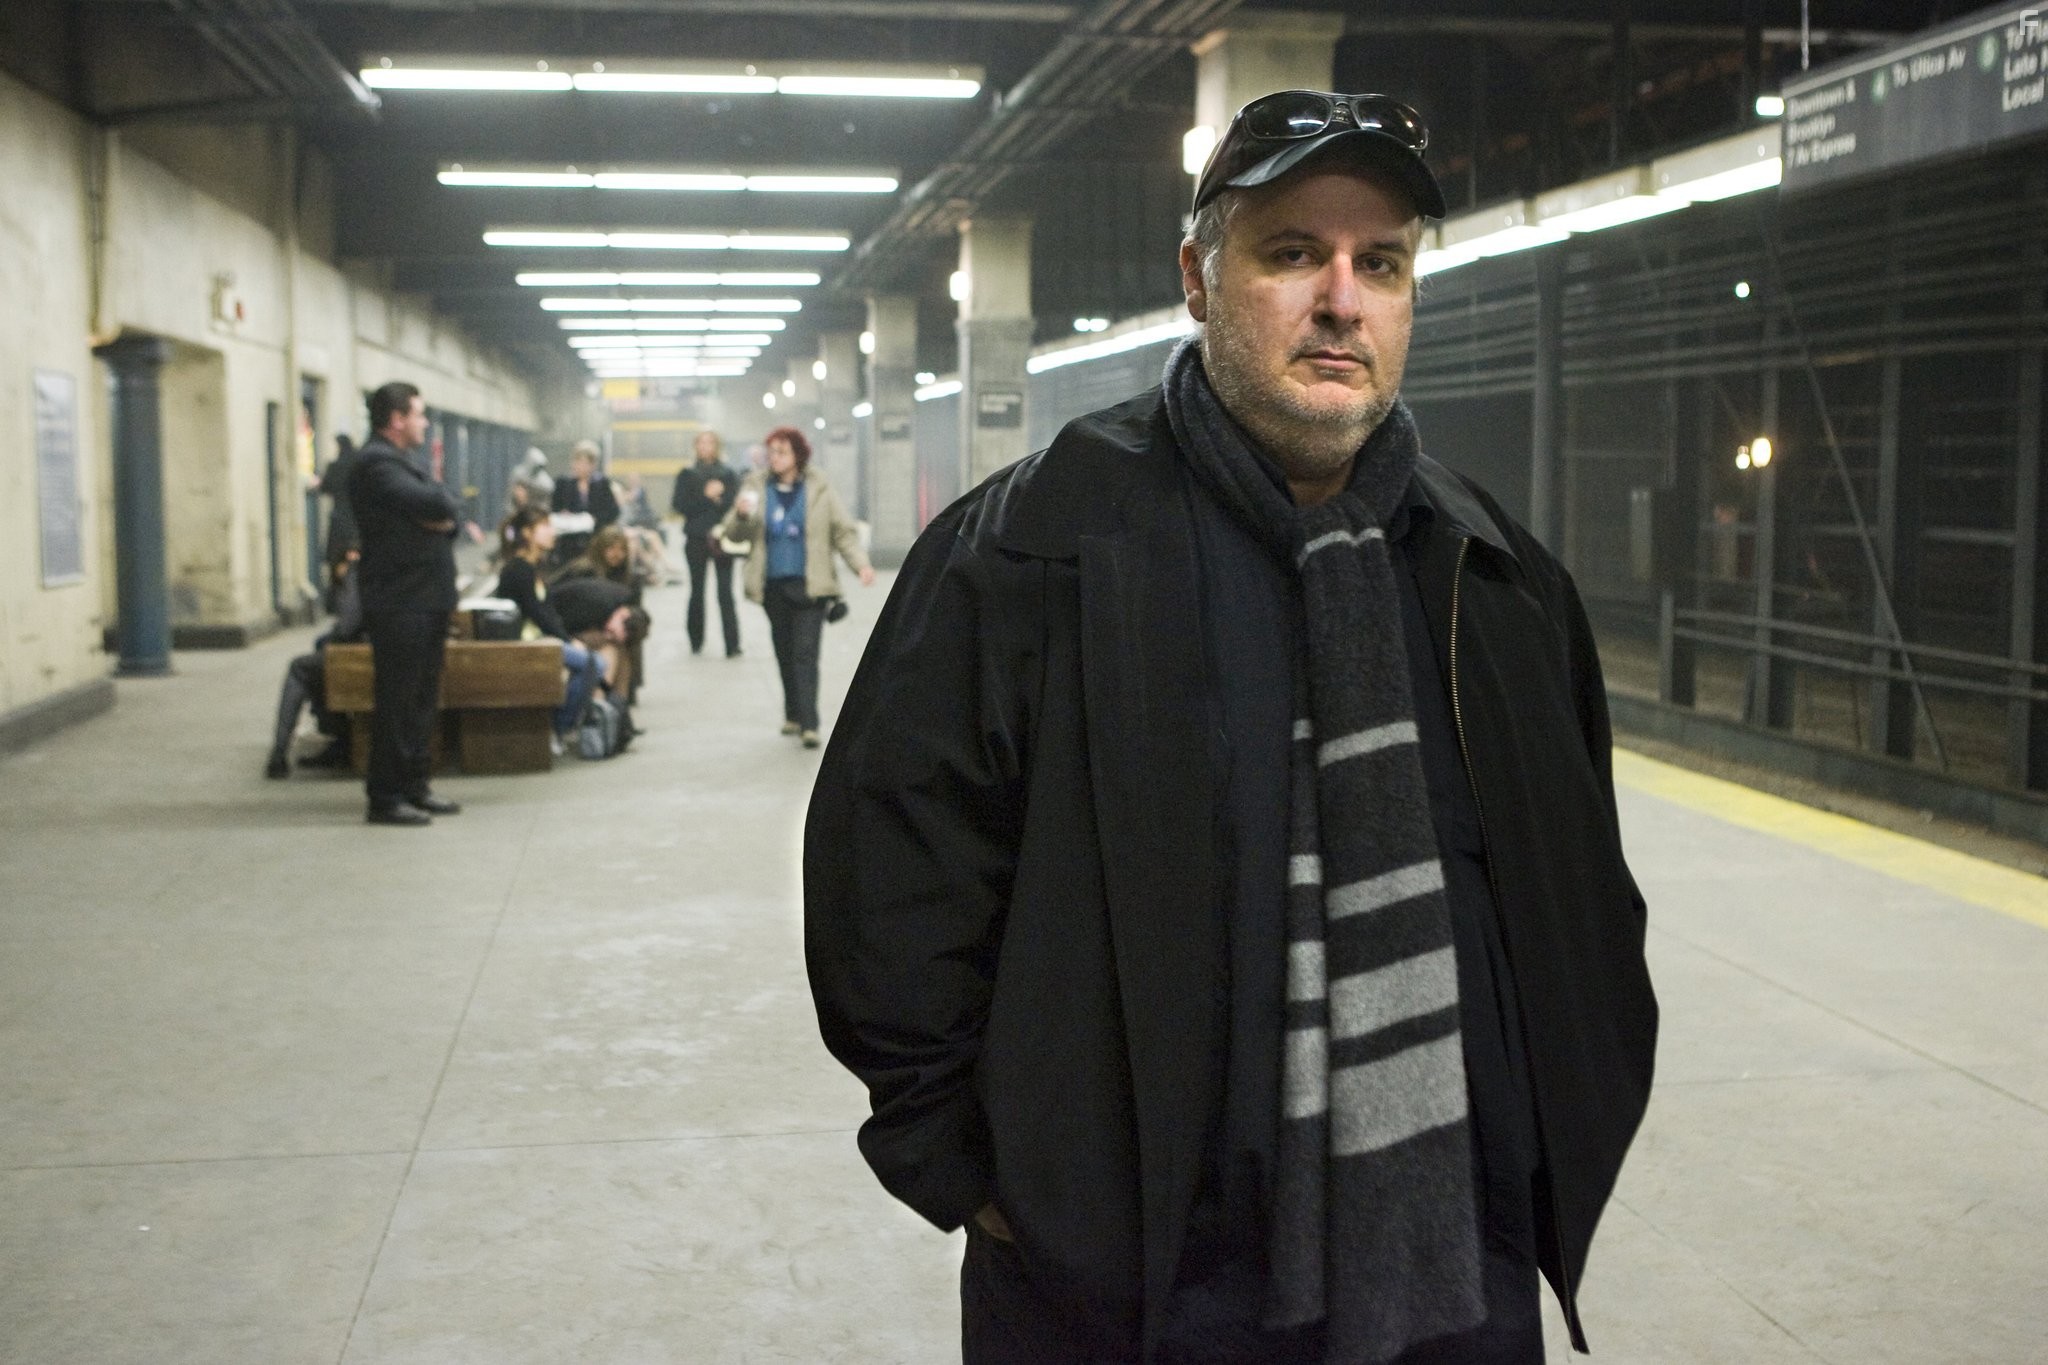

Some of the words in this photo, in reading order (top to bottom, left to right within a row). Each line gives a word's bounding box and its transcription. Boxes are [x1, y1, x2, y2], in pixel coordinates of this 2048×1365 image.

[1893, 62, 1909, 88] To
[1946, 45, 1966, 72] Av
[2004, 53, 2038, 82] Late
[2003, 77, 2045, 112] Local
